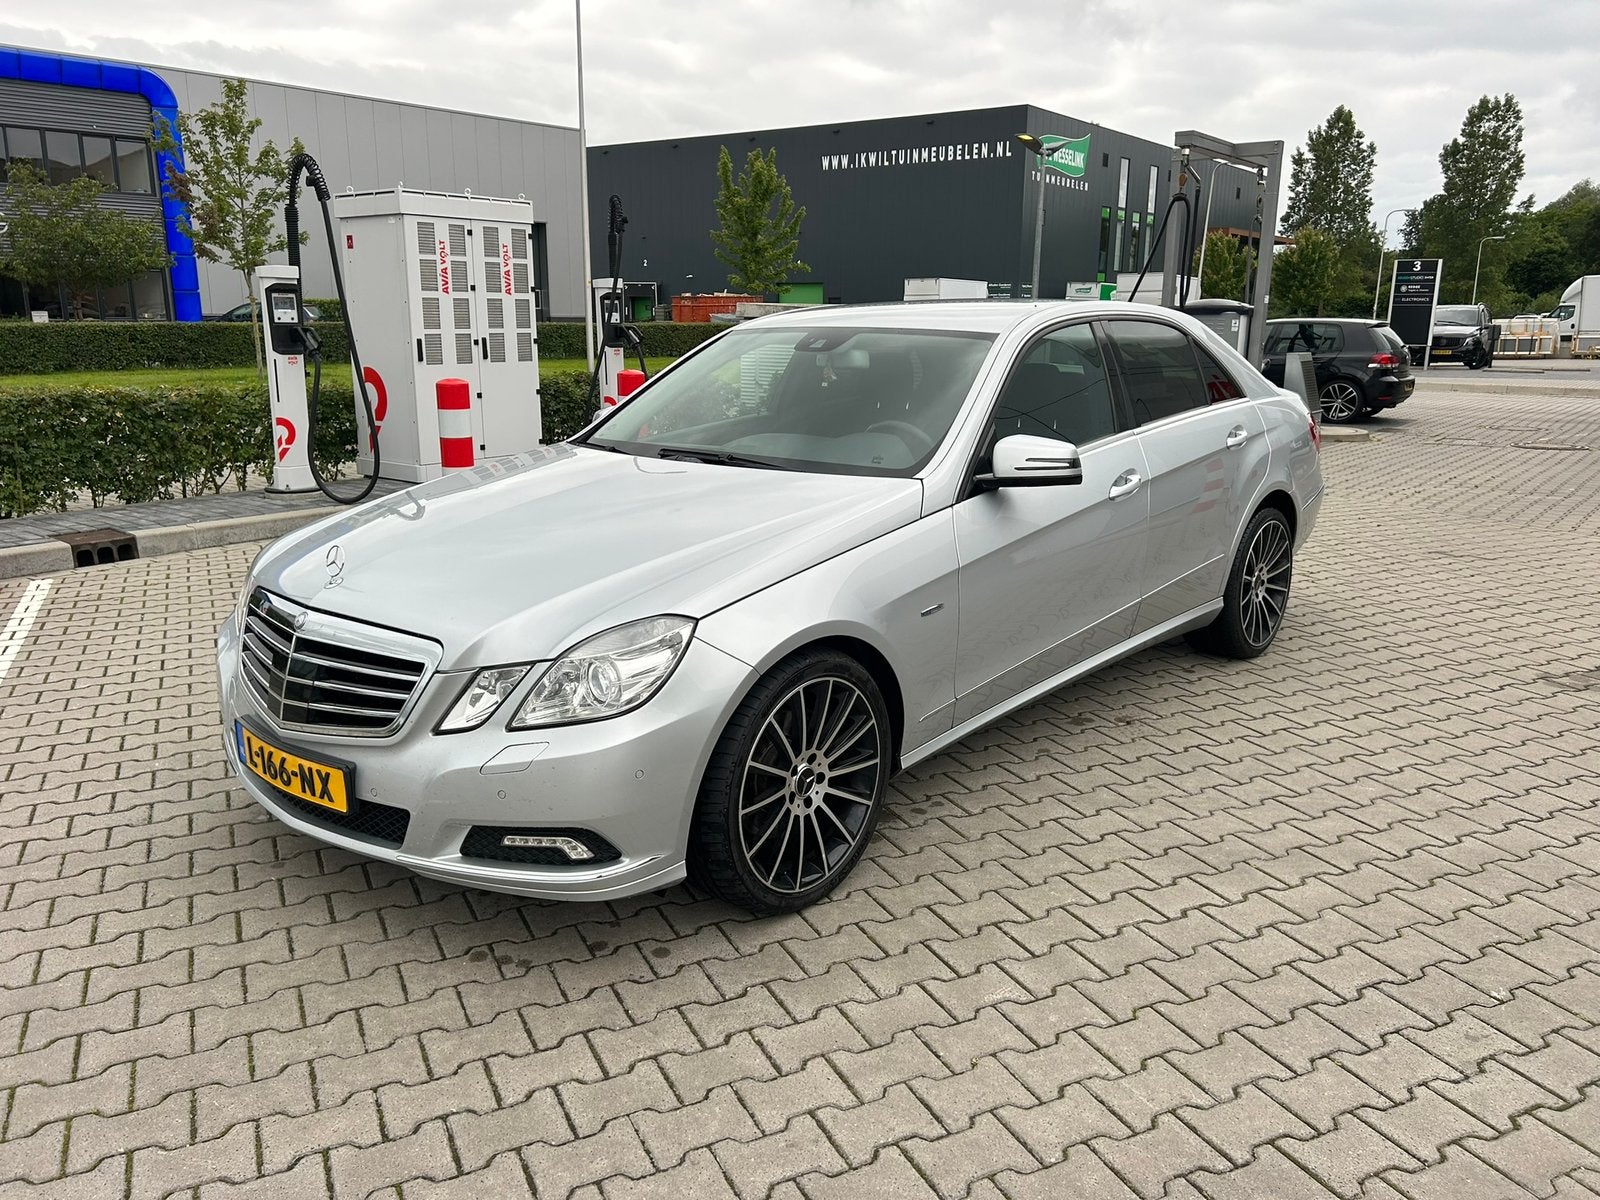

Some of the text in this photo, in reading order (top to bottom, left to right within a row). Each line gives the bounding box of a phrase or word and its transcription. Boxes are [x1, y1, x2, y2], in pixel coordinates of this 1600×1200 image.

[821, 140, 1012, 171] WWW.IKWILTUINMEUBELEN.NL
[1031, 170, 1089, 191] TUNMEUBELEN
[438, 239, 449, 265] VOLT
[502, 243, 512, 268] VOLT
[643, 259, 648, 267] 2
[1412, 260, 1421, 272] 3
[246, 735, 335, 803] L-166-NX
